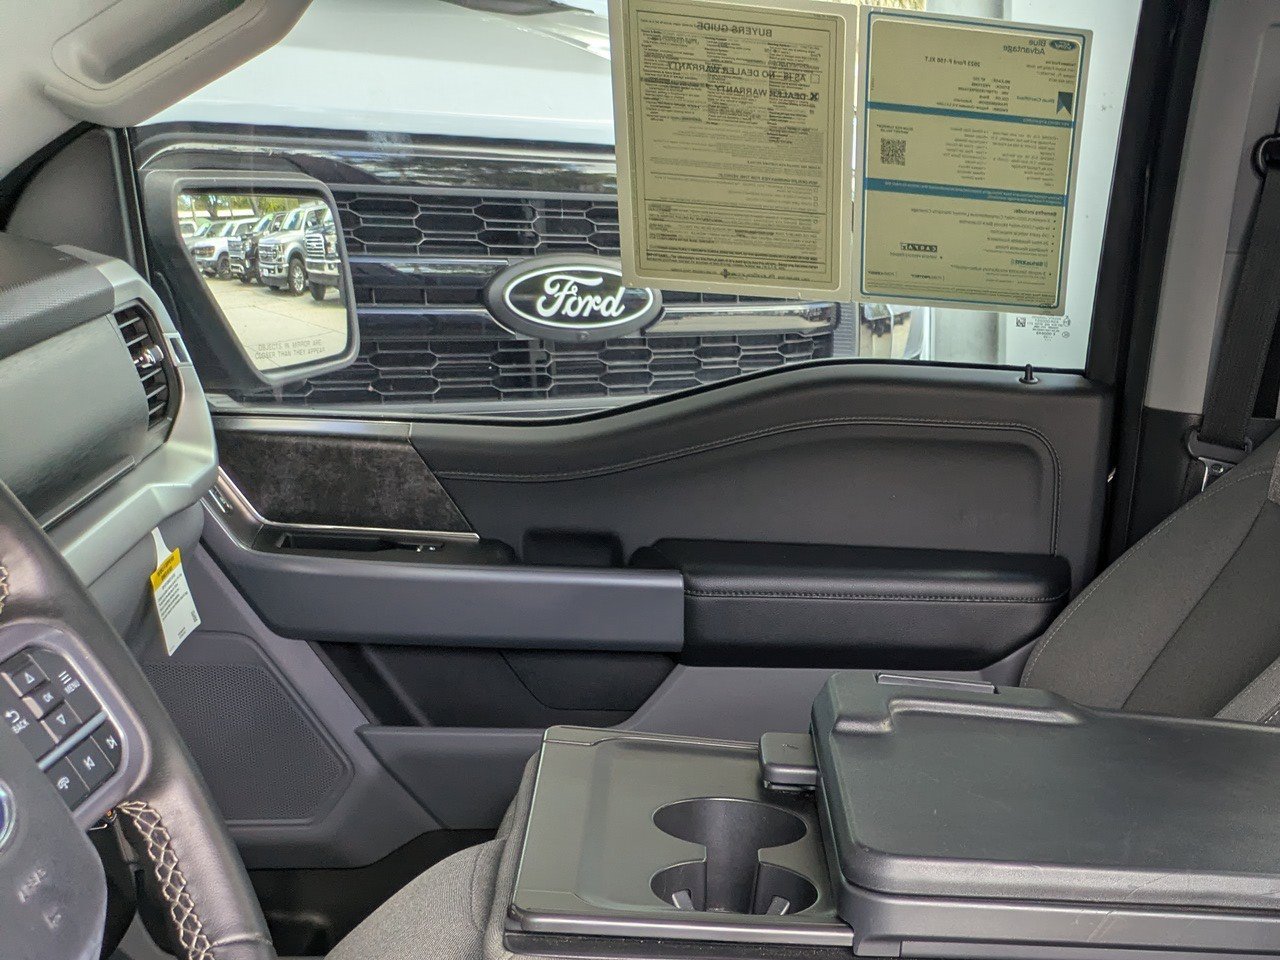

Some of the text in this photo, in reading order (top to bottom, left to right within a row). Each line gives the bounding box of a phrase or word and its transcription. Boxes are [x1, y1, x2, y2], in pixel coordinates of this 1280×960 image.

[536, 274, 625, 317] Ford
[258, 342, 282, 351] OBJECTS
[255, 351, 275, 359] CLOSER
